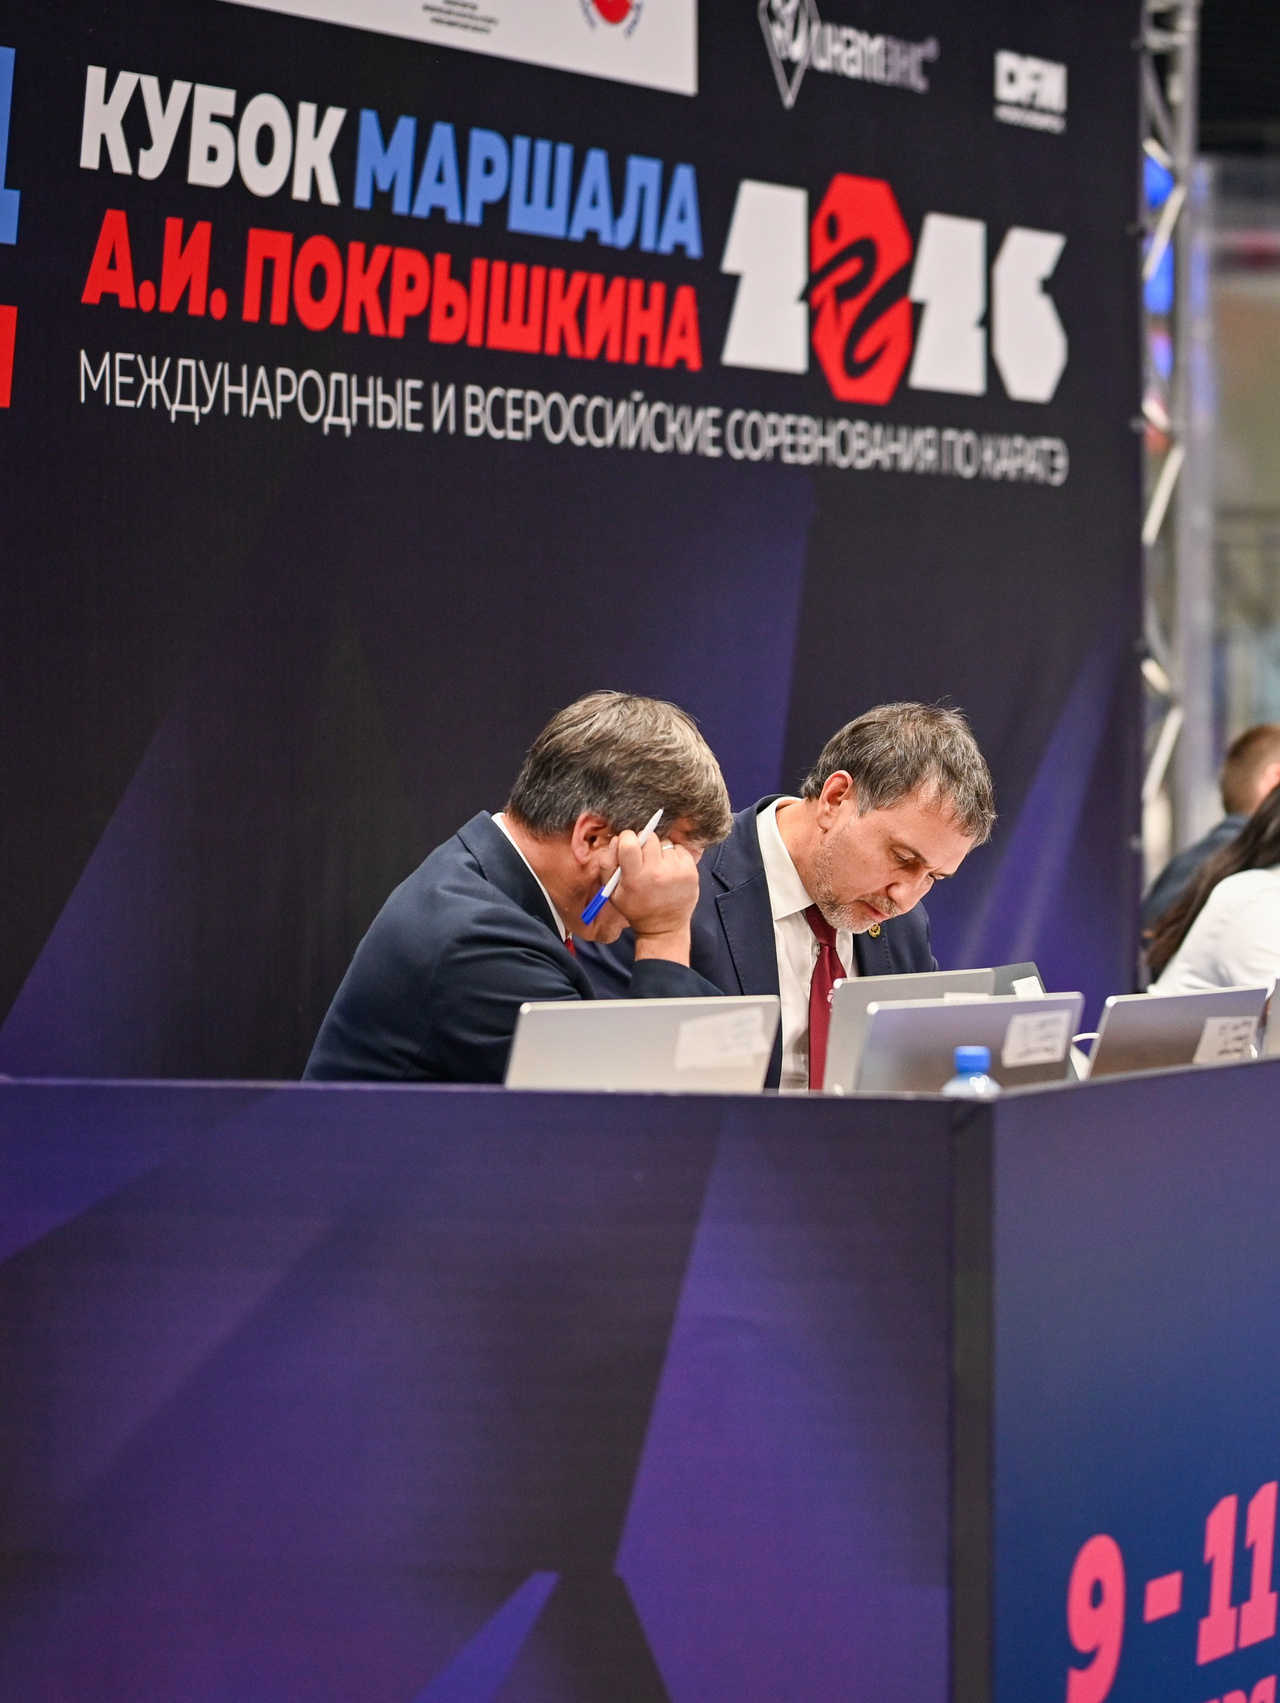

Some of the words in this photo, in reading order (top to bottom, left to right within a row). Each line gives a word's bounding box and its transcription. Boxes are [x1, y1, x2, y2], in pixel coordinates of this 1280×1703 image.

[80, 65, 346, 206] КУБОК
[354, 109, 702, 258] МАРШАЛА
[81, 208, 228, 321] А.И.
[242, 227, 702, 372] ПОКРЫШКИНА
[80, 349, 424, 438] МЕЖДУНАРОДНЫЕ
[431, 382, 456, 435] И
[464, 384, 723, 459] ВСЕРОССИЙСКИЕ
[725, 408, 940, 474] СОРЕВНОВАНИЯ
[941, 425, 981, 480] ПО
[1066, 1534, 1126, 1703] 9
[1196, 1481, 1278, 1666] 11
